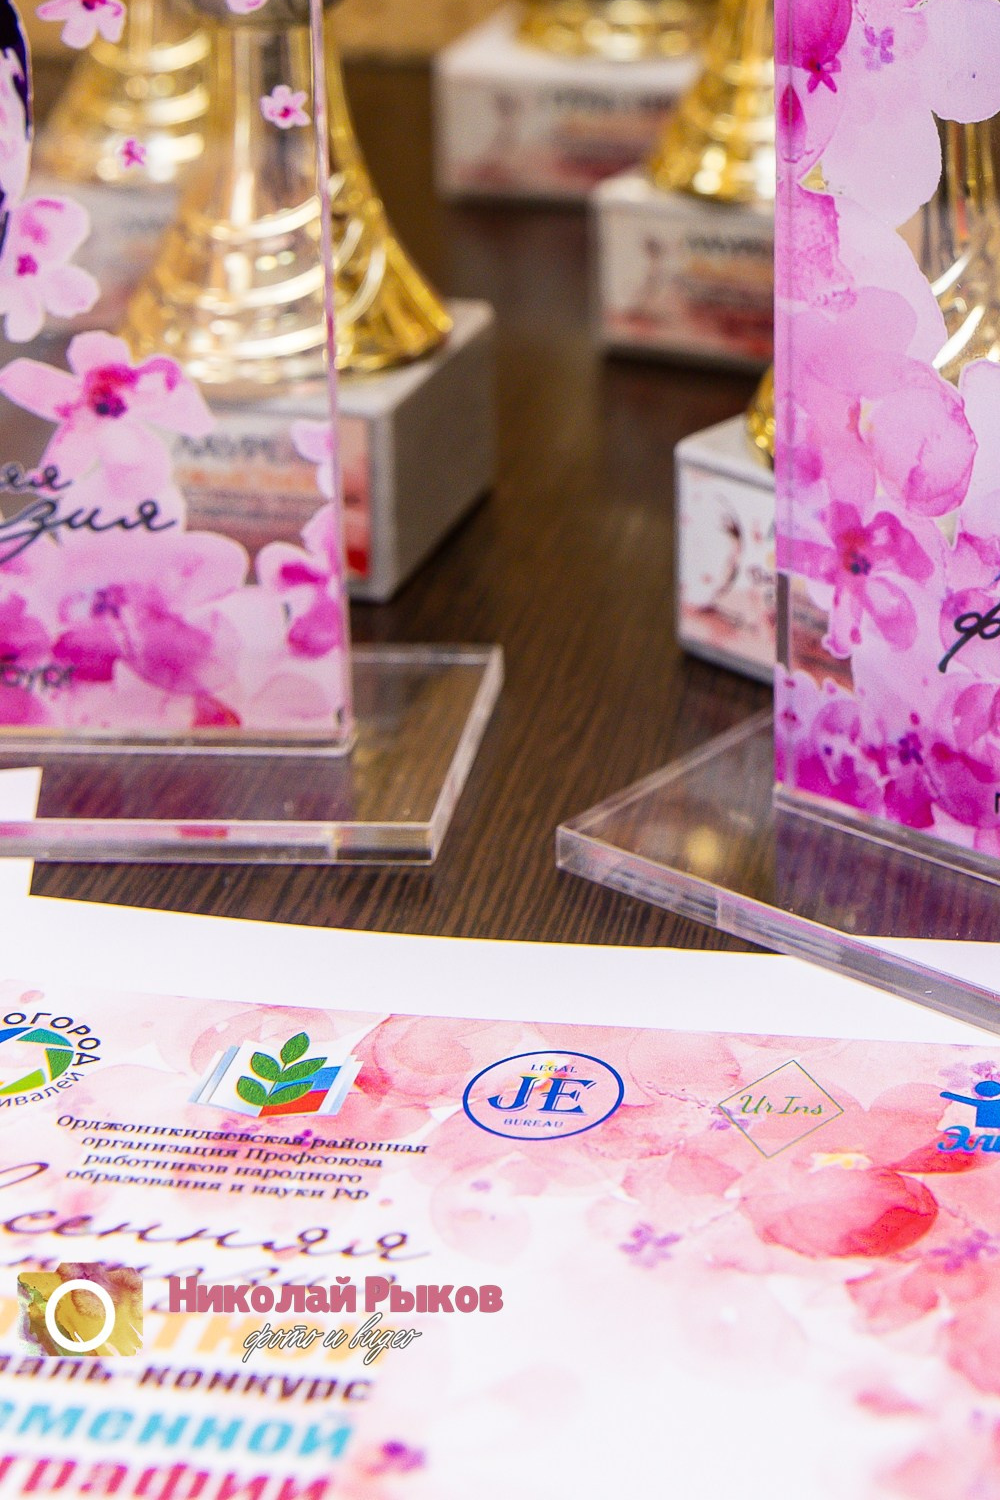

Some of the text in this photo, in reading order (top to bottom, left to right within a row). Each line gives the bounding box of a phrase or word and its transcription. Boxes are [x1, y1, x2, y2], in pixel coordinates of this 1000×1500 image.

[530, 1063, 578, 1074] LEGAL
[487, 1075, 597, 1116] JE
[56, 1114, 429, 1154] Орджоникидзевская районная
[503, 1118, 564, 1129] BUREAU
[81, 1136, 383, 1168] организация Профсоюза
[65, 1169, 369, 1200] образования и науки РФ
[83, 1153, 363, 1185] работников народного
